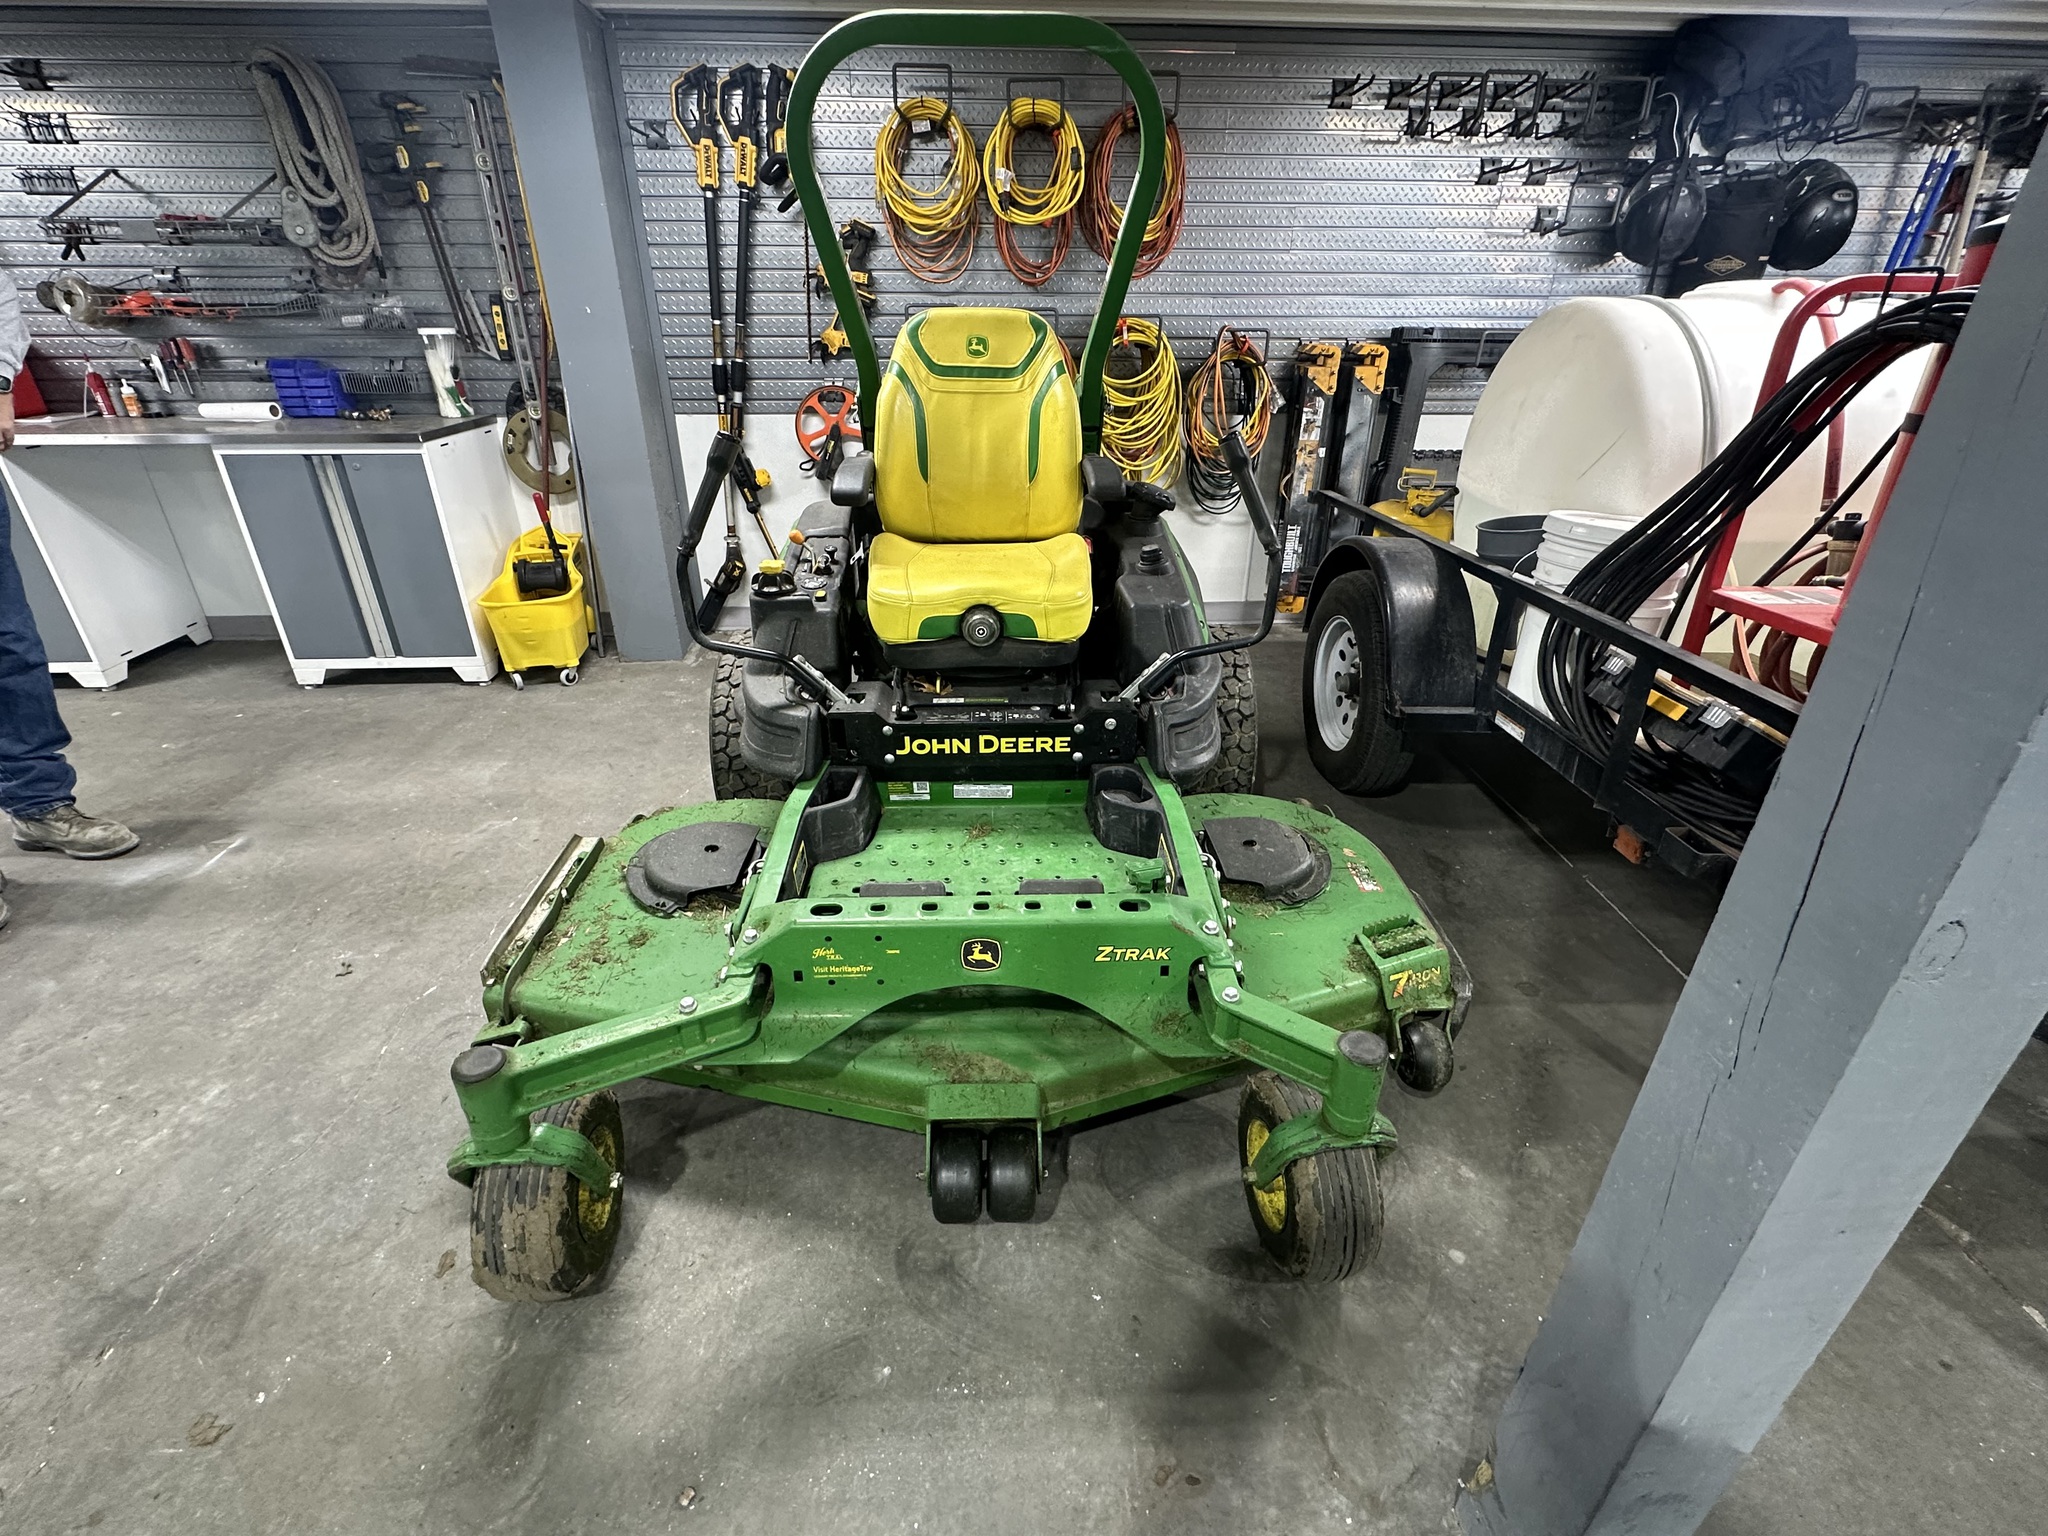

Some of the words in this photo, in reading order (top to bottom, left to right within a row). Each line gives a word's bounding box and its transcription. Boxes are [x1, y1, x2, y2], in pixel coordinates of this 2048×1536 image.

[1282, 524, 1297, 574] TOUGHBUILT
[896, 736, 971, 755] JOHN
[979, 735, 1072, 754] DEERE
[1094, 946, 1172, 962] ZTRAK
